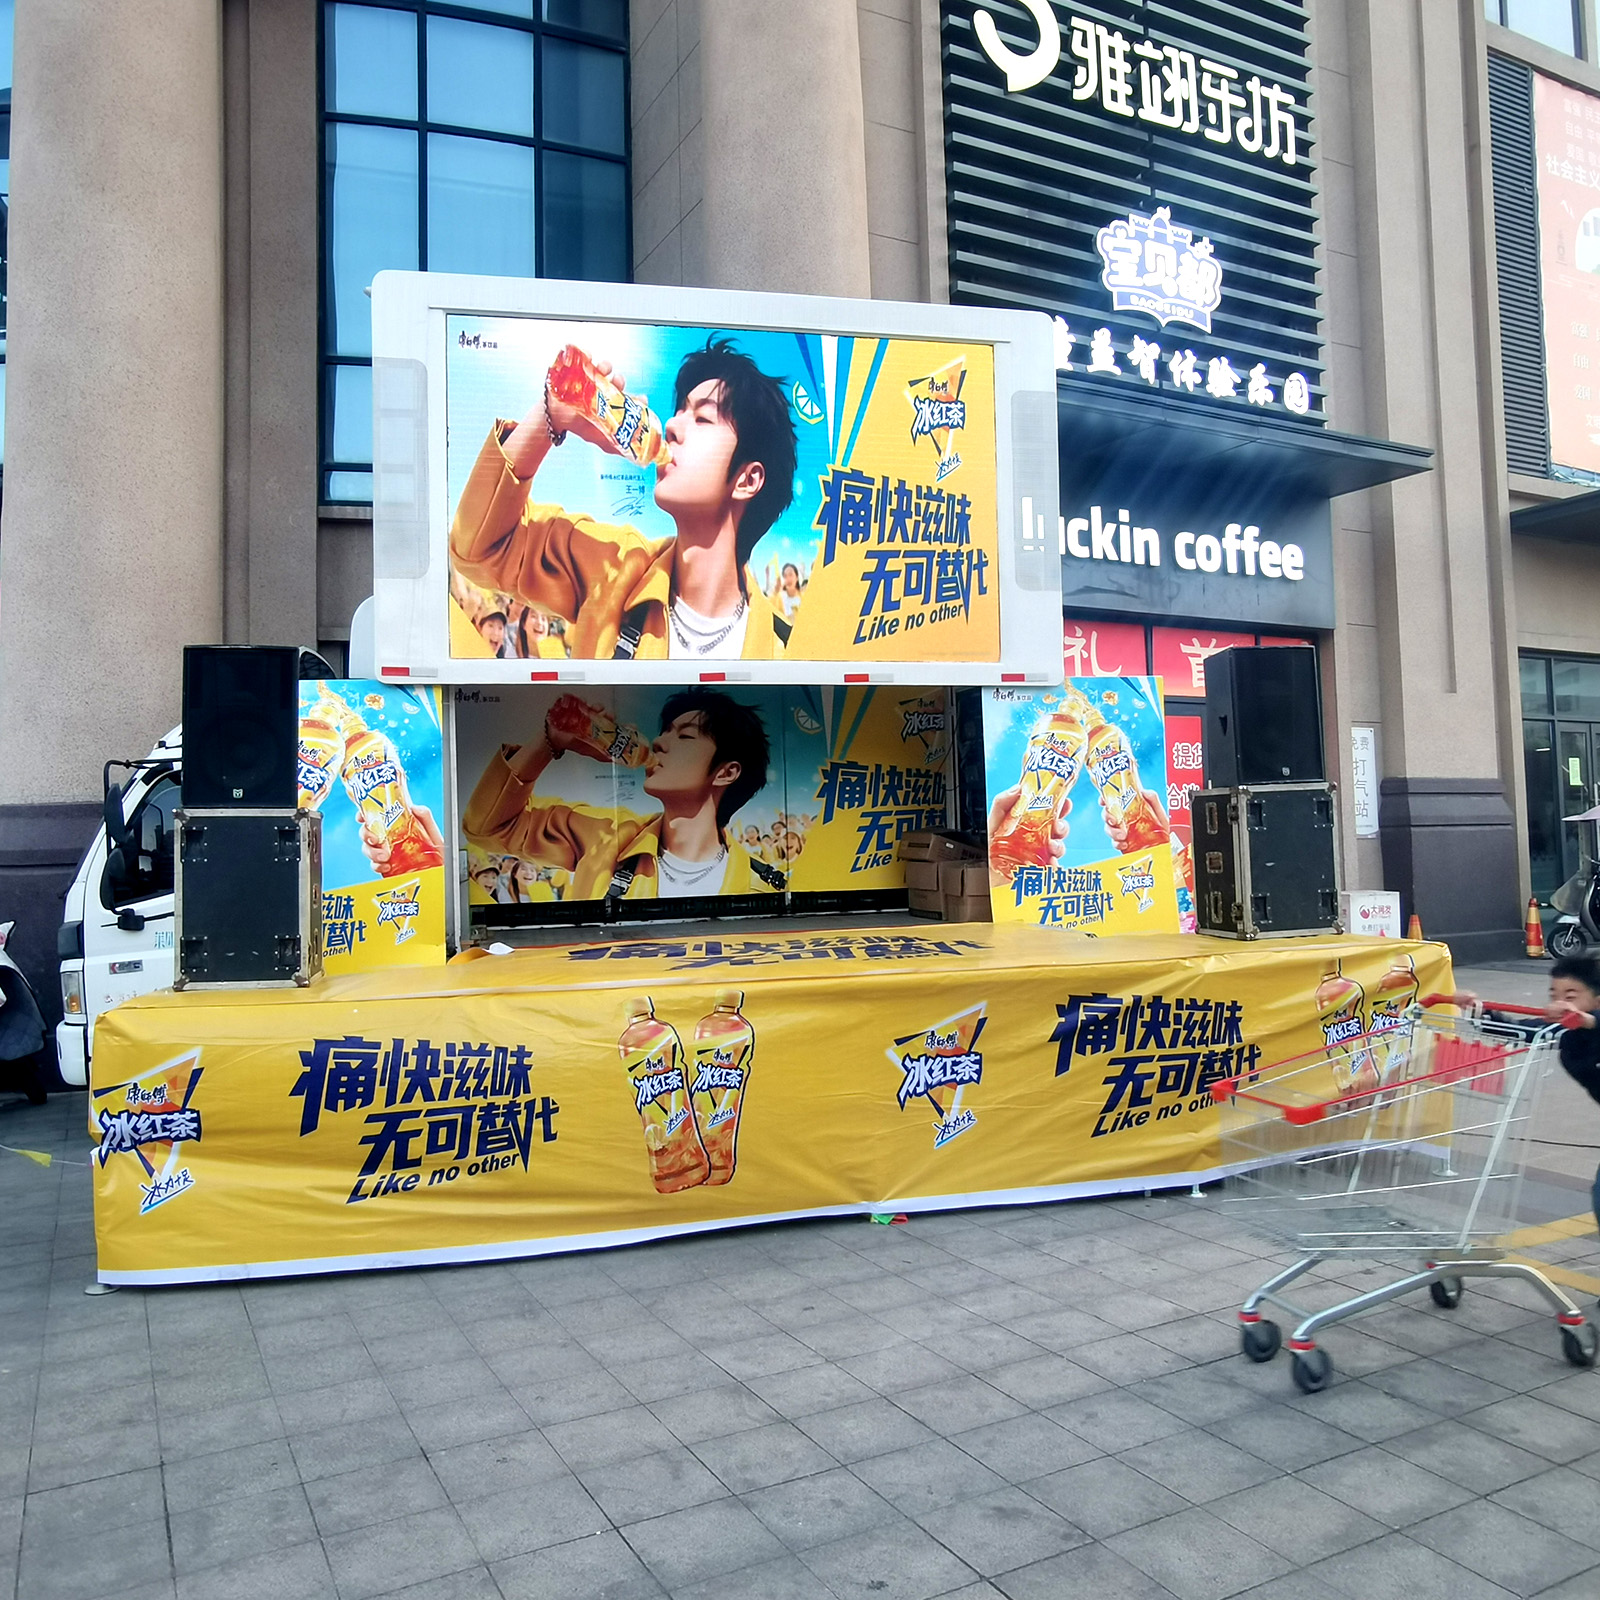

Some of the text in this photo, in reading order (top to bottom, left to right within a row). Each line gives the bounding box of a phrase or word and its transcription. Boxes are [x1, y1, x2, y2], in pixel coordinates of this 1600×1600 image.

[1546, 153, 1600, 190] 社会主义
[1102, 236, 1217, 305] 宝贝都
[911, 397, 964, 441] 冰红茶
[817, 468, 972, 568] 痛快滋味
[1175, 523, 1304, 580] coffee
[859, 549, 989, 624] 无可替代
[853, 603, 963, 645] Like no other
[1064, 626, 1122, 677] 礼
[347, 762, 396, 802] 冰红茶
[1025, 746, 1076, 780] 冰红茶
[1091, 753, 1130, 786] 冰红茶
[1353, 758, 1369, 818] 打气站
[850, 852, 891, 873] Like
[1011, 866, 1102, 906] 痛快滋味
[378, 901, 419, 926] 冰红茶
[1038, 892, 1114, 924] 无可替代
[1066, 921, 1078, 929] no
[1080, 915, 1100, 925] other
[322, 920, 367, 955] 替代
[323, 947, 347, 957] other
[1048, 993, 1243, 1077] 痛快滋味
[1324, 1018, 1361, 1047] 冰红茶
[289, 1035, 533, 1137] 痛快滋味
[634, 1069, 682, 1110] 冰红茶
[692, 1063, 743, 1096] 冰红茶
[899, 1053, 981, 1102] 冰红茶
[1099, 1044, 1262, 1115] 无可替代
[100, 1110, 199, 1161] 冰红茶
[358, 1096, 560, 1177] 无可替代
[1090, 1094, 1219, 1138] Like no oth
[141, 1169, 194, 1205] 冰力十足
[346, 1153, 520, 1204] Like no other
